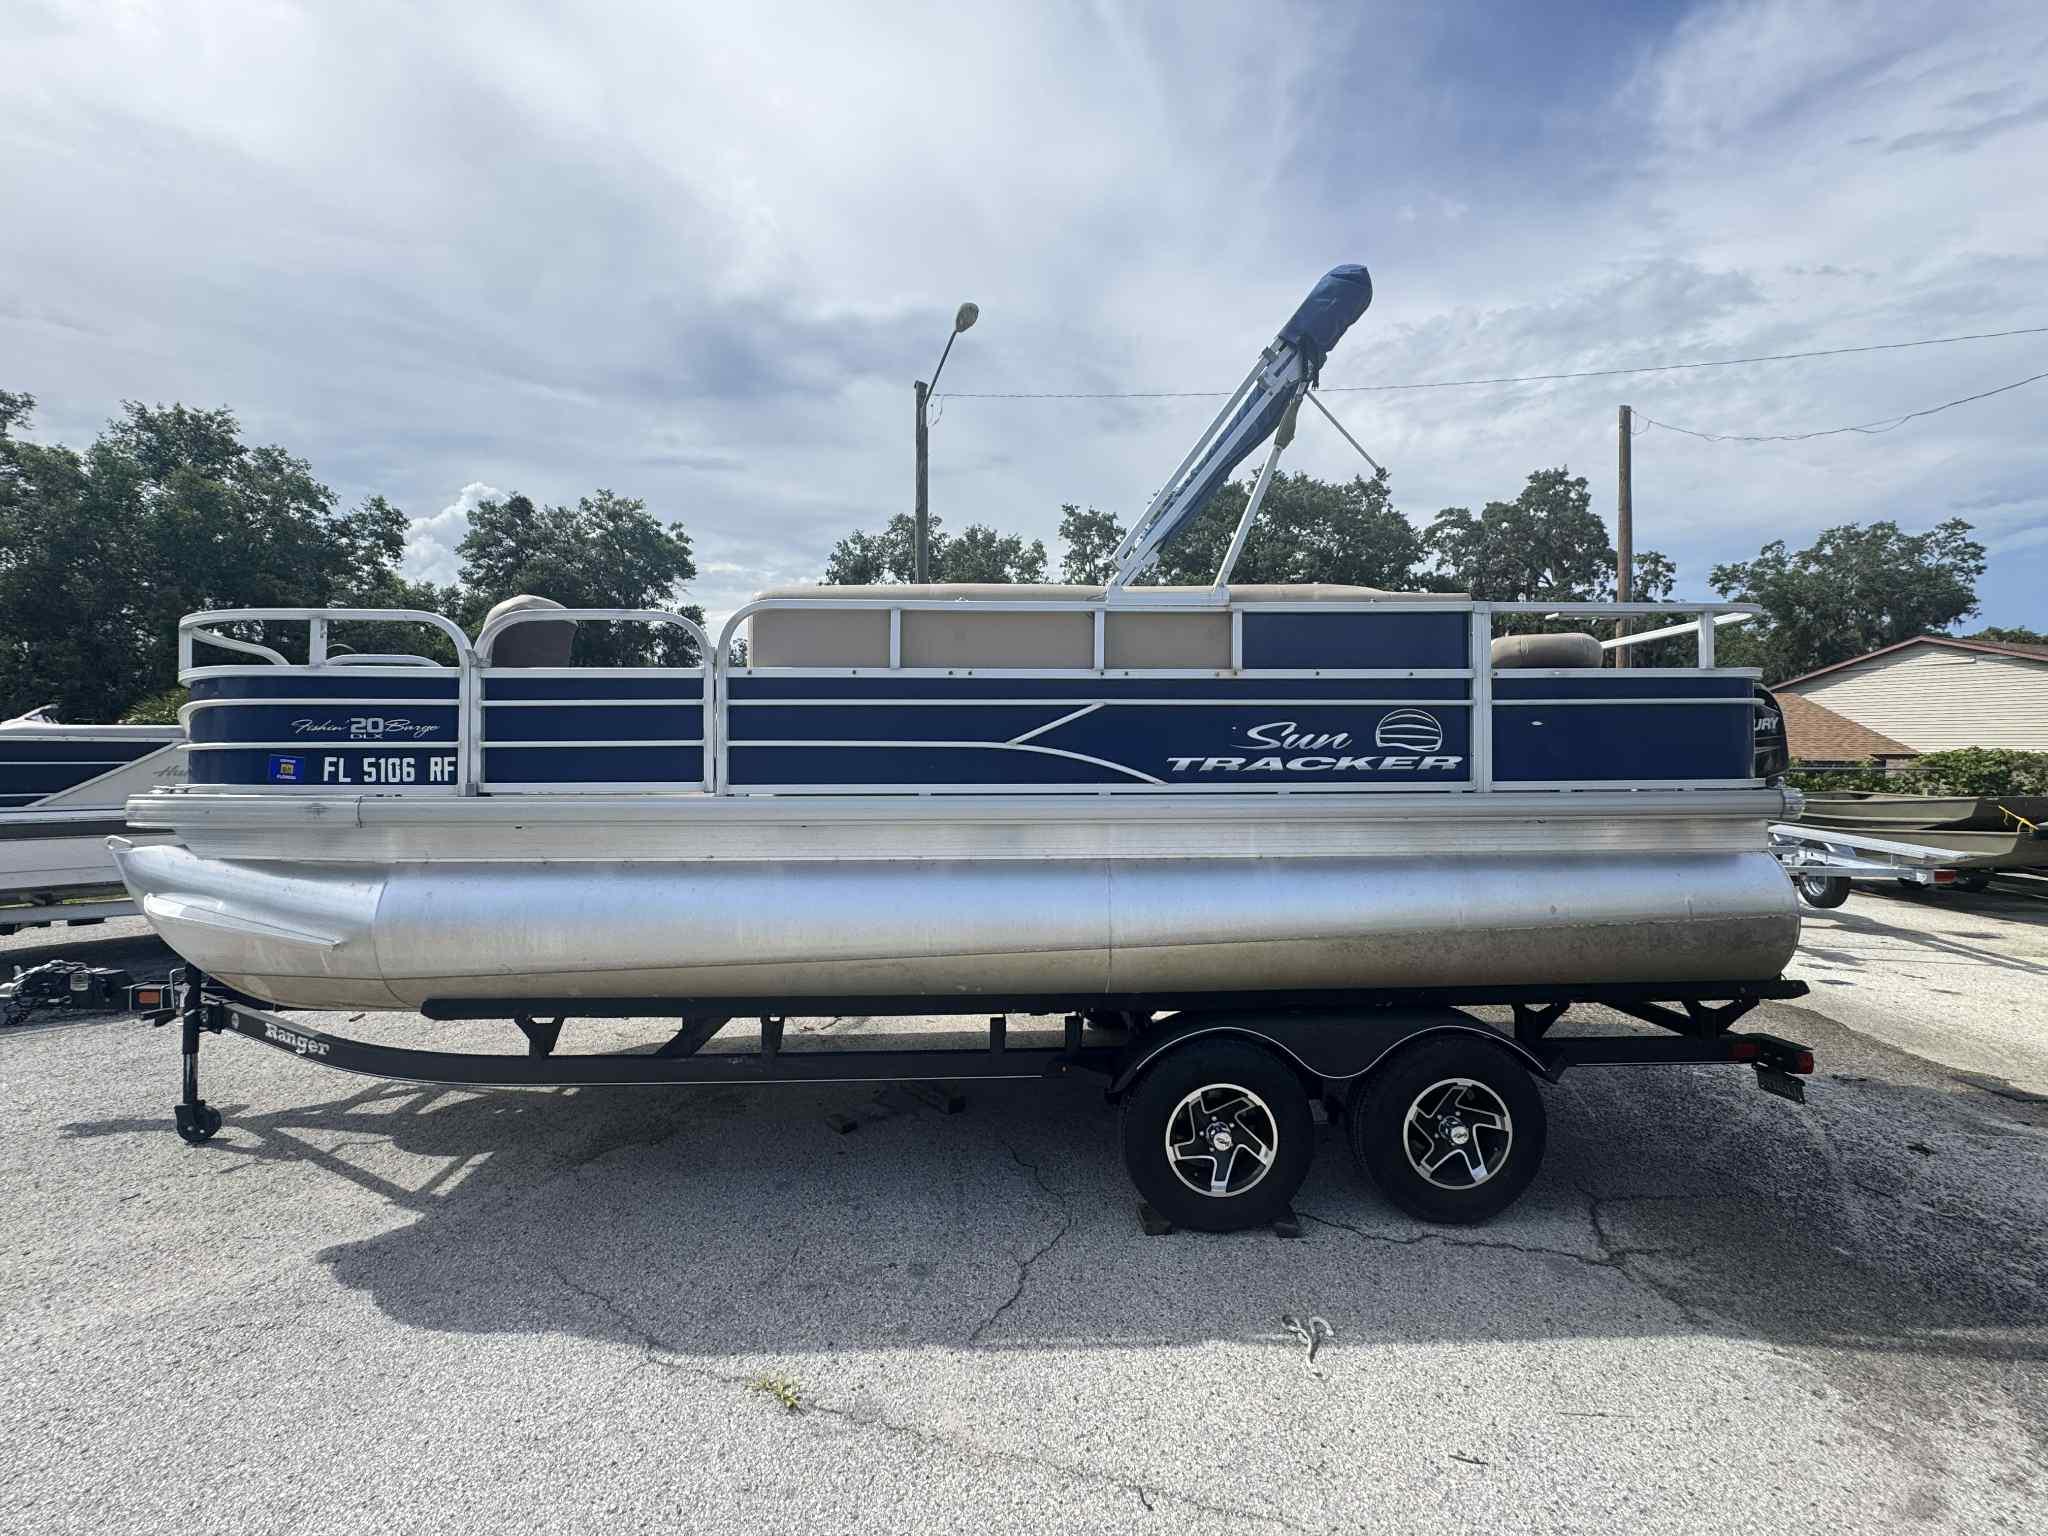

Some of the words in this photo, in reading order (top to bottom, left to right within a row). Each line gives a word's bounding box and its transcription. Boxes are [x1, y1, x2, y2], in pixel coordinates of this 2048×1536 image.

[350, 717, 384, 733] 20
[1231, 721, 1352, 750] Sun
[323, 756, 352, 782] FL
[363, 757, 416, 783] 5106
[429, 756, 457, 782] RF
[1166, 755, 1464, 773] TRACKER
[264, 1022, 330, 1056] Ranger
